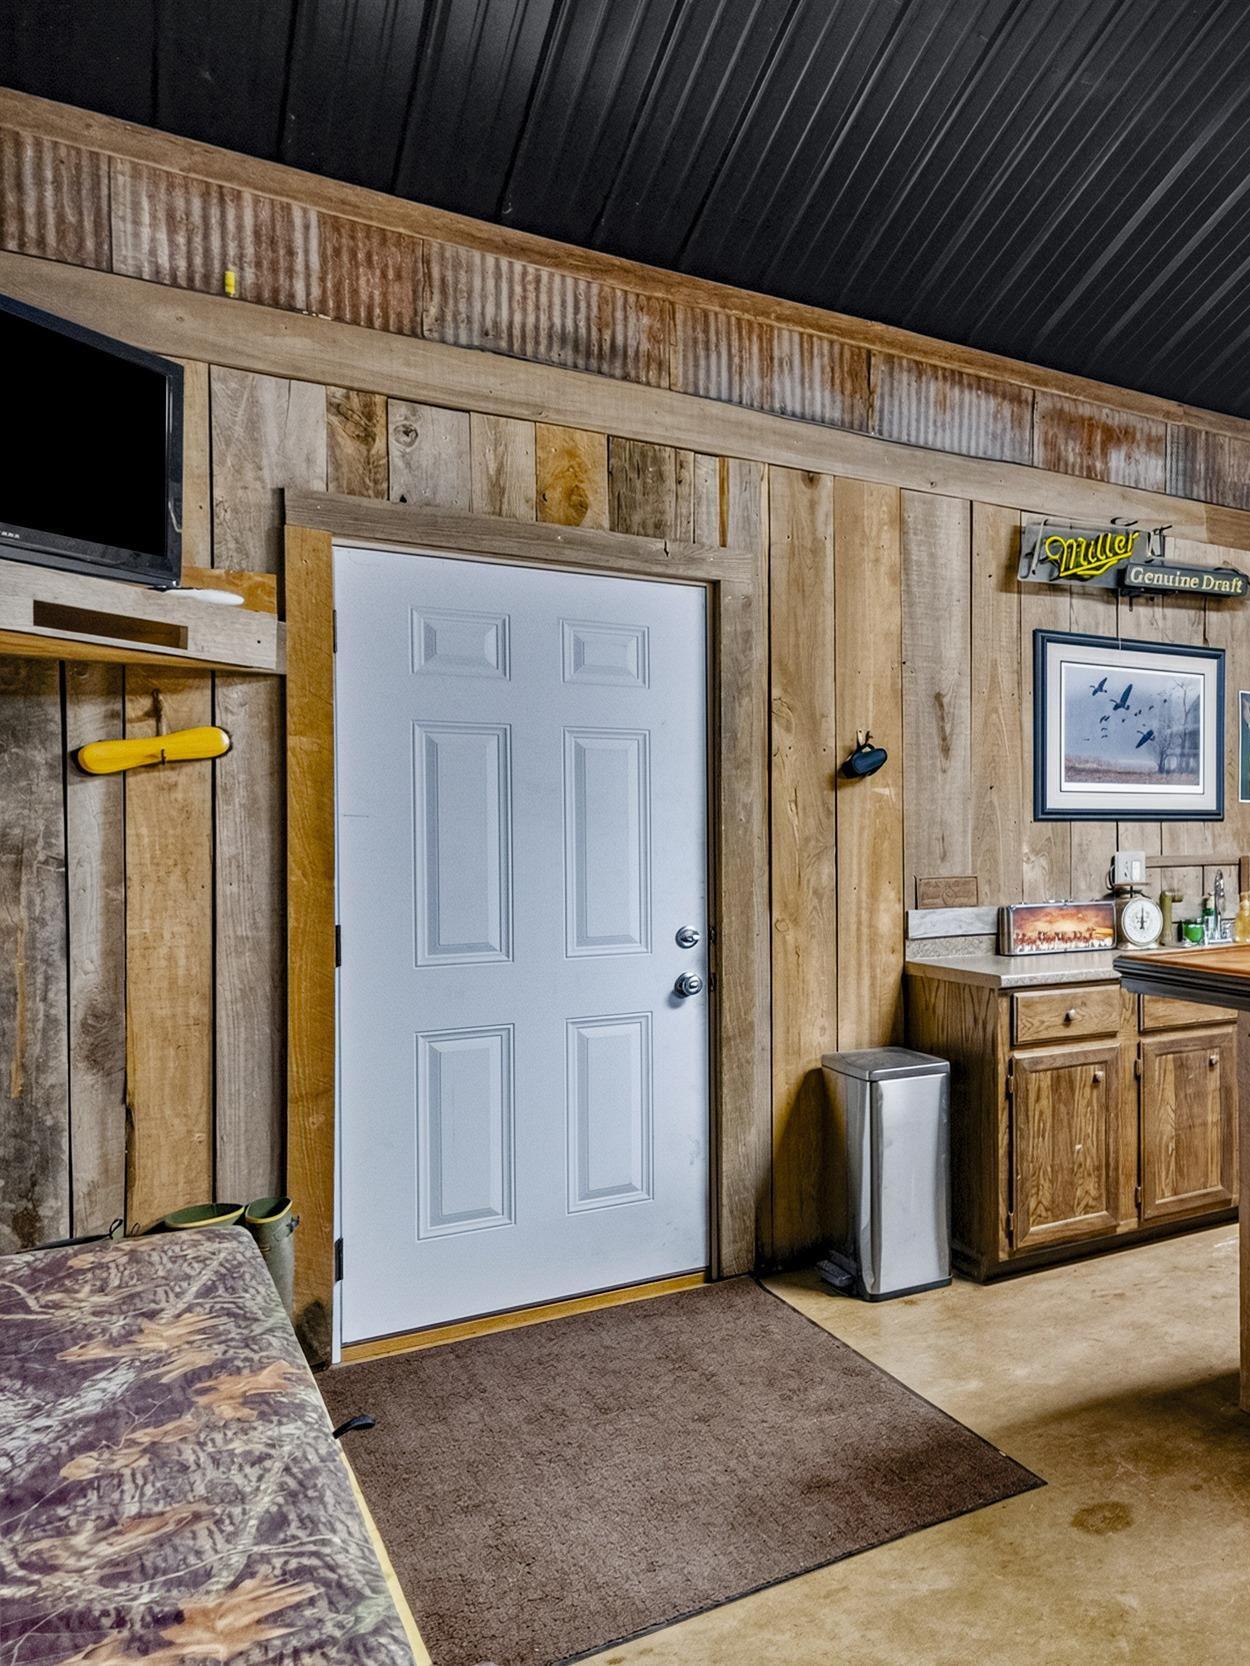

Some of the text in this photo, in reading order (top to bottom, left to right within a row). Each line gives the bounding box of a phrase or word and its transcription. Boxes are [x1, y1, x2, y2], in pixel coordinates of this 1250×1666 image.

[1044, 532, 1140, 577] Miller
[1130, 567, 1244, 594] Genuine Draft
